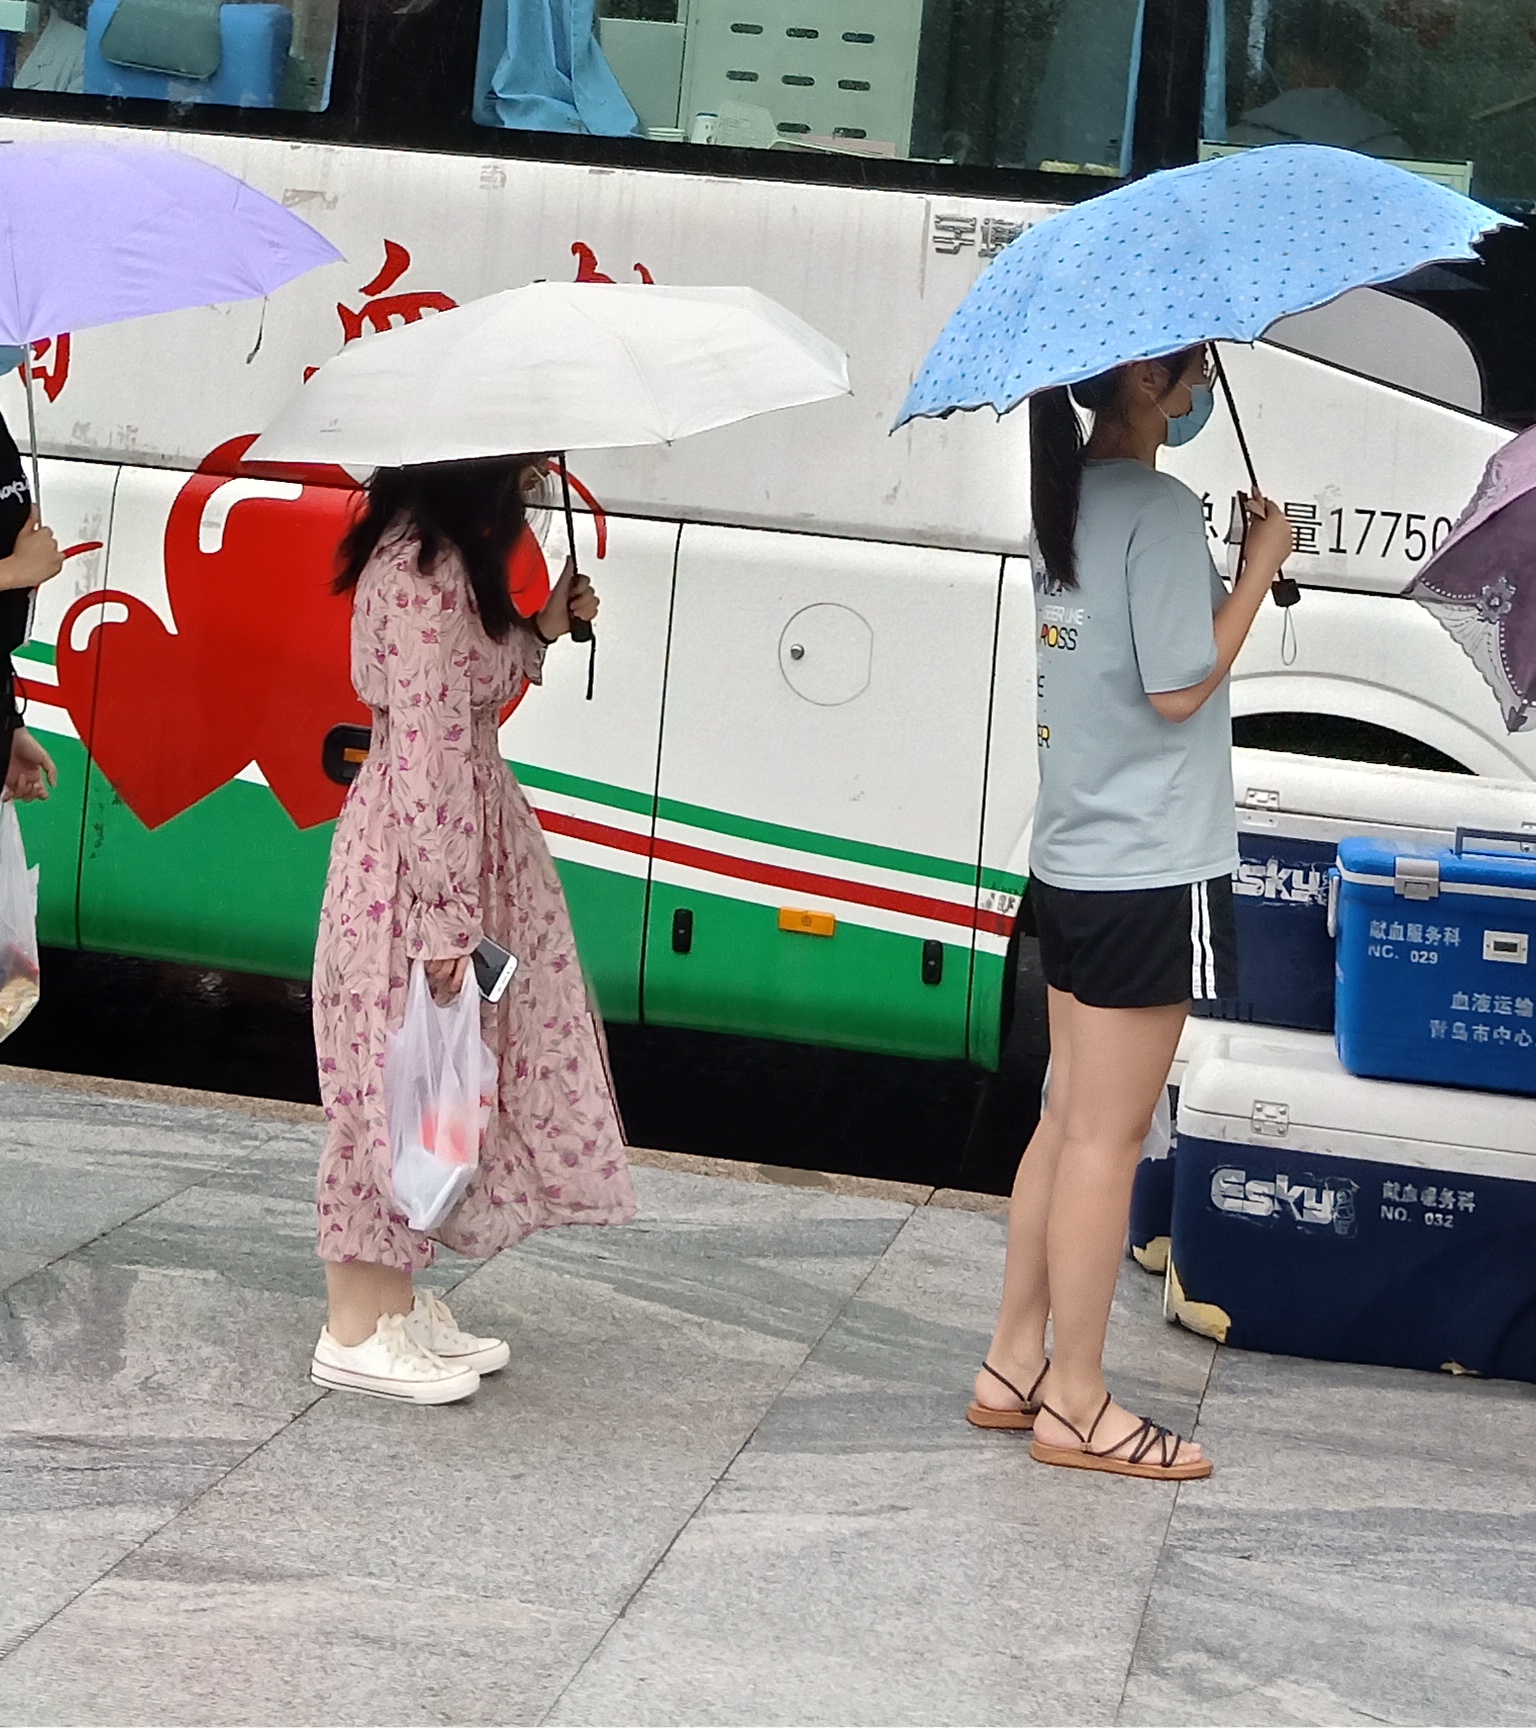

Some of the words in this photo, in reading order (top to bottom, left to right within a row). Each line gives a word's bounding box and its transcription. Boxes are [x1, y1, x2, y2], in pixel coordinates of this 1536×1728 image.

[1231, 858, 1320, 902] sky
[1369, 919, 1462, 948] 献血服务科
[1410, 949, 1439, 965] 029
[1424, 1212, 1454, 1229] 032
